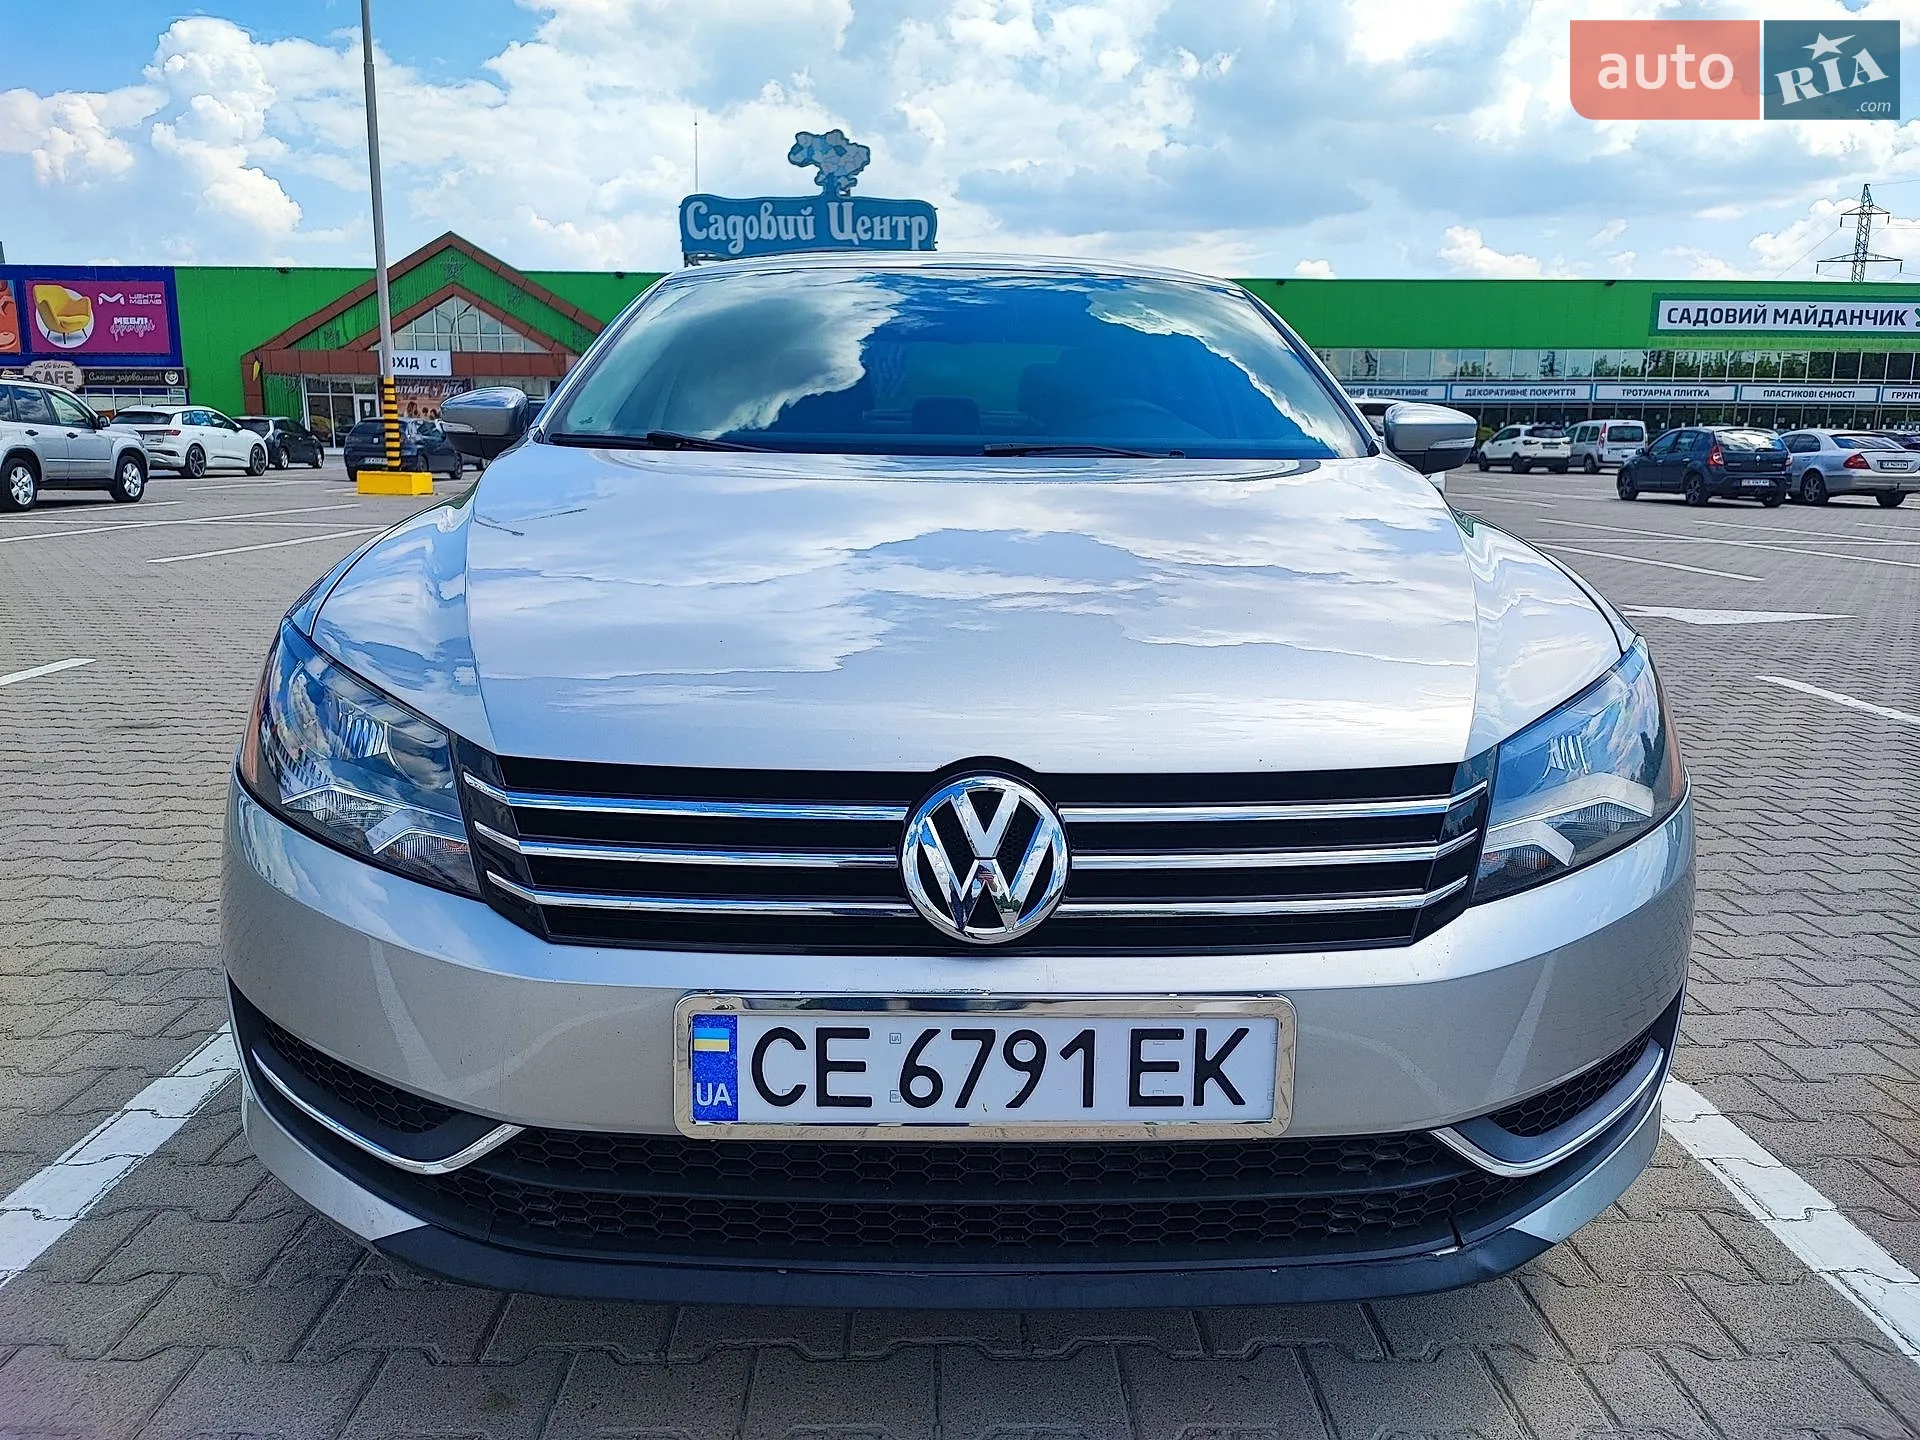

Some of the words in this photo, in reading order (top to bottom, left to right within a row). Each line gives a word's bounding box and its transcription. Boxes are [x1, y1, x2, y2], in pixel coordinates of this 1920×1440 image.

[686, 201, 816, 254] Садовий
[826, 202, 929, 250] Центр
[1667, 304, 1768, 327] САДОВИЙ
[1773, 304, 1908, 328] МАЙДАНЧИК
[395, 384, 430, 394] ВІТАЙТЕ
[1465, 387, 1528, 398] ДЕКОРАТИВНЕ
[1529, 387, 1576, 397] ПОКРИТТЯ
[1622, 388, 1672, 398] ТРОТУАРНА
[1673, 388, 1710, 398] ПЛИТКА
[1763, 389, 1817, 398] ПЛАСТИКОВІ
[750, 1026, 874, 1108] CE
[898, 1027, 1097, 1109] 6791
[1128, 1026, 1251, 1108] EK
[695, 1082, 733, 1107] UA
